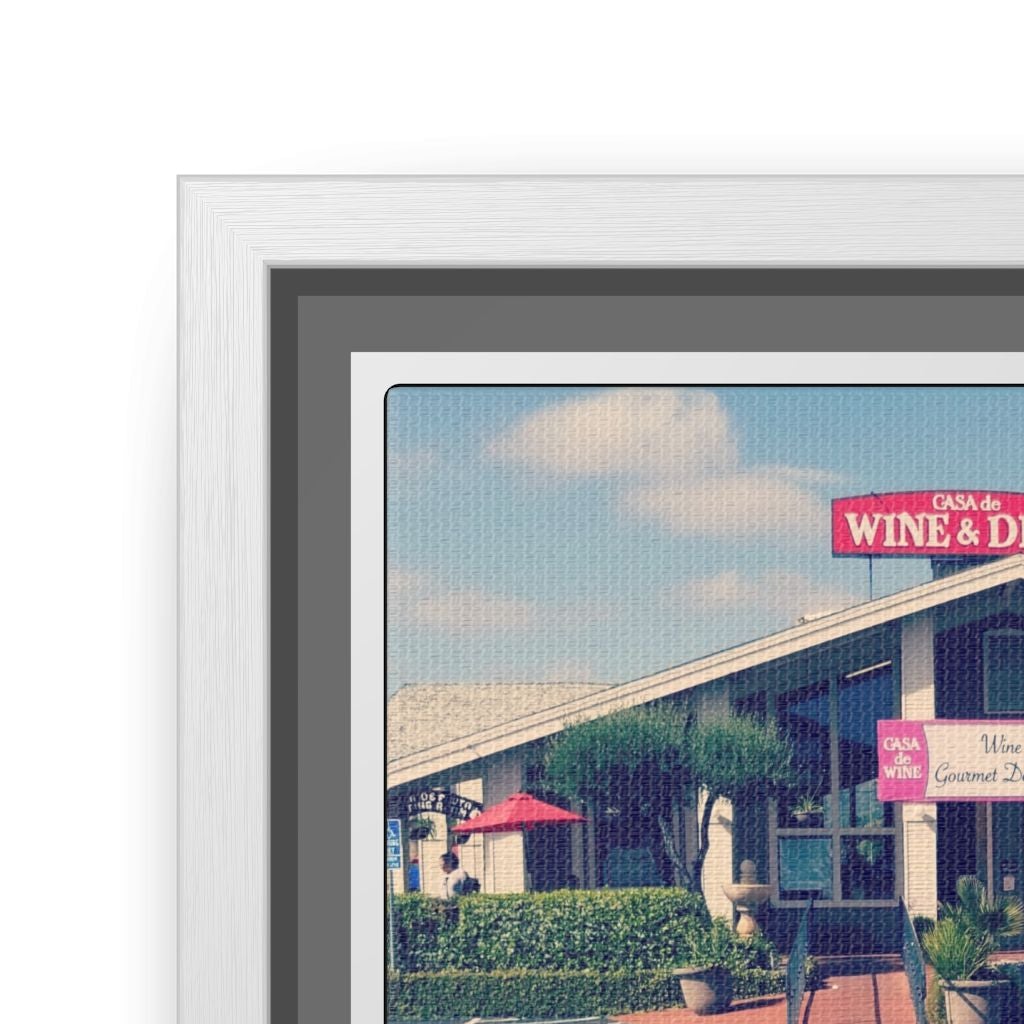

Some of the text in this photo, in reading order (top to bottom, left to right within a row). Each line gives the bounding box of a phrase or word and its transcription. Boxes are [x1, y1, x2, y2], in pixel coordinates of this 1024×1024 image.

[932, 494, 1001, 511] CASA de
[844, 512, 951, 548] WINE
[956, 518, 980, 546] &
[883, 736, 921, 751] CASA
[980, 733, 1021, 754] Wine
[894, 752, 911, 765] de
[883, 766, 922, 780] WINE
[934, 763, 998, 788] Gourmet
